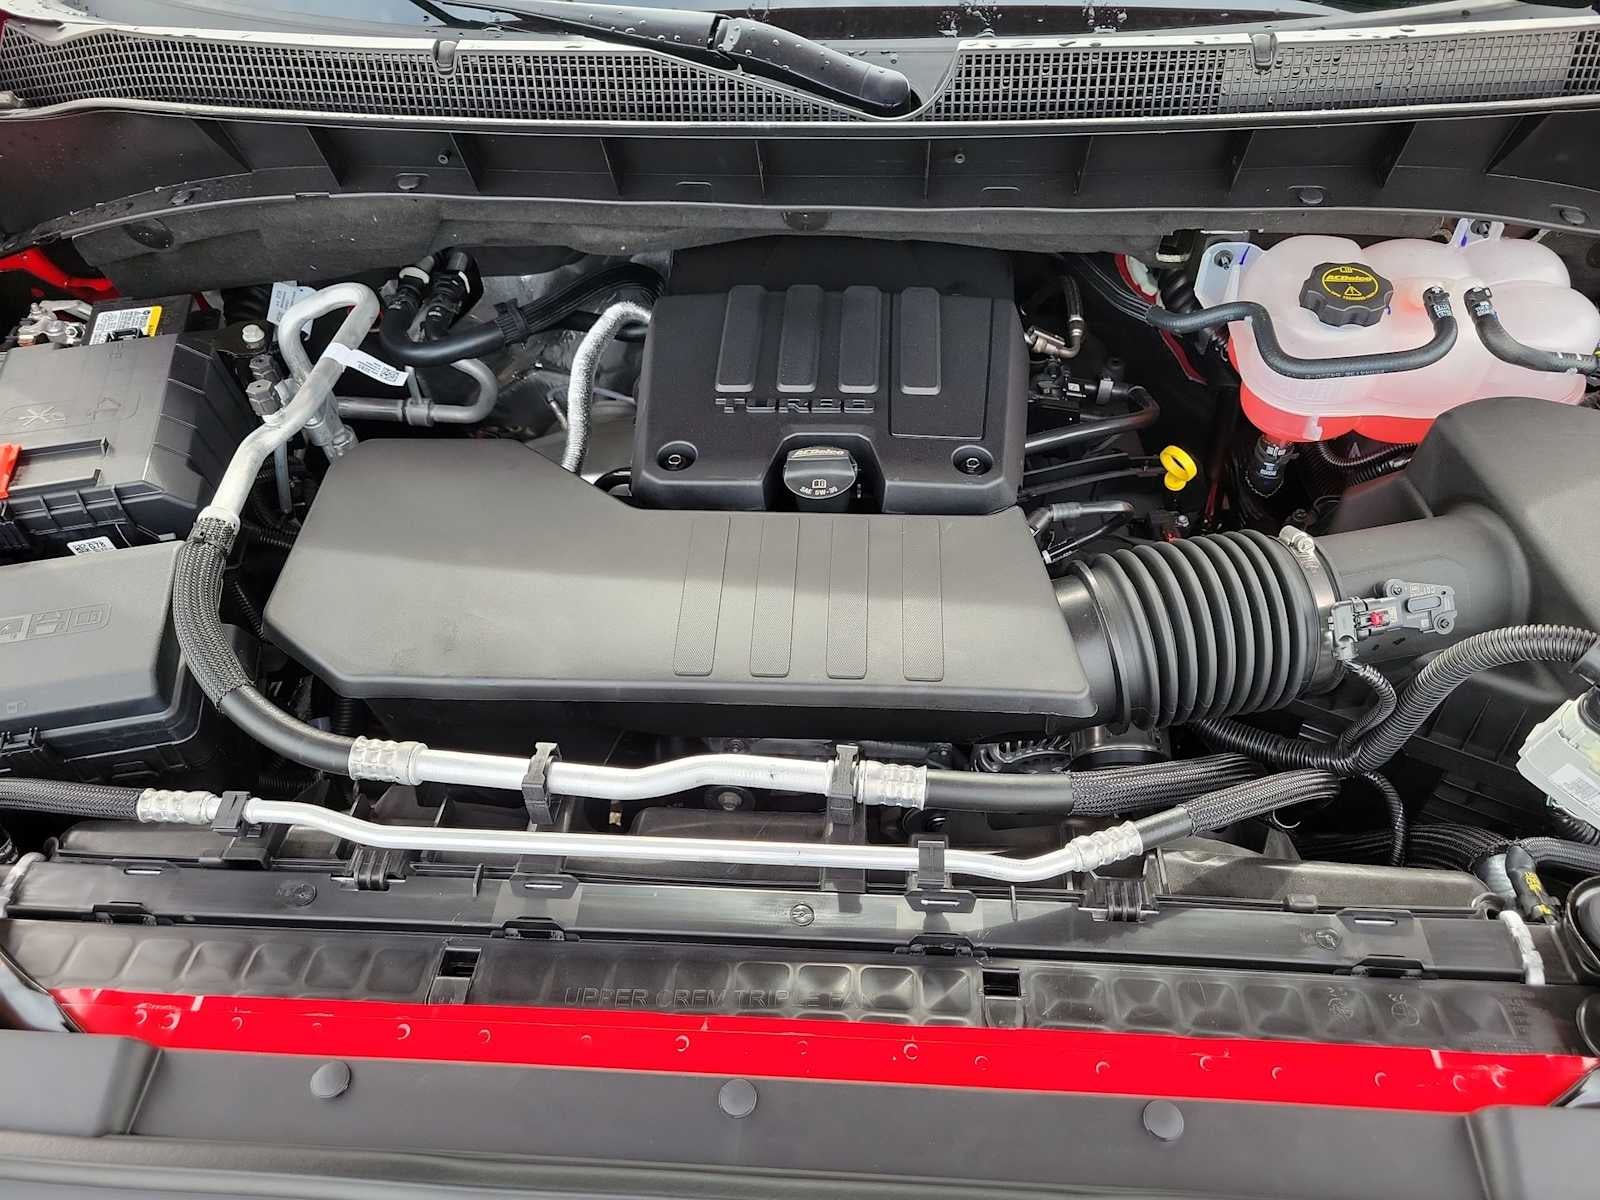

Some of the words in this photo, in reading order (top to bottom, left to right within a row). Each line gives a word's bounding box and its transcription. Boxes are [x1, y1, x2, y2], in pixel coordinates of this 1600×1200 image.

[715, 398, 875, 414] TURBO
[800, 486, 812, 495] SAE
[564, 987, 648, 1008] UPPER
